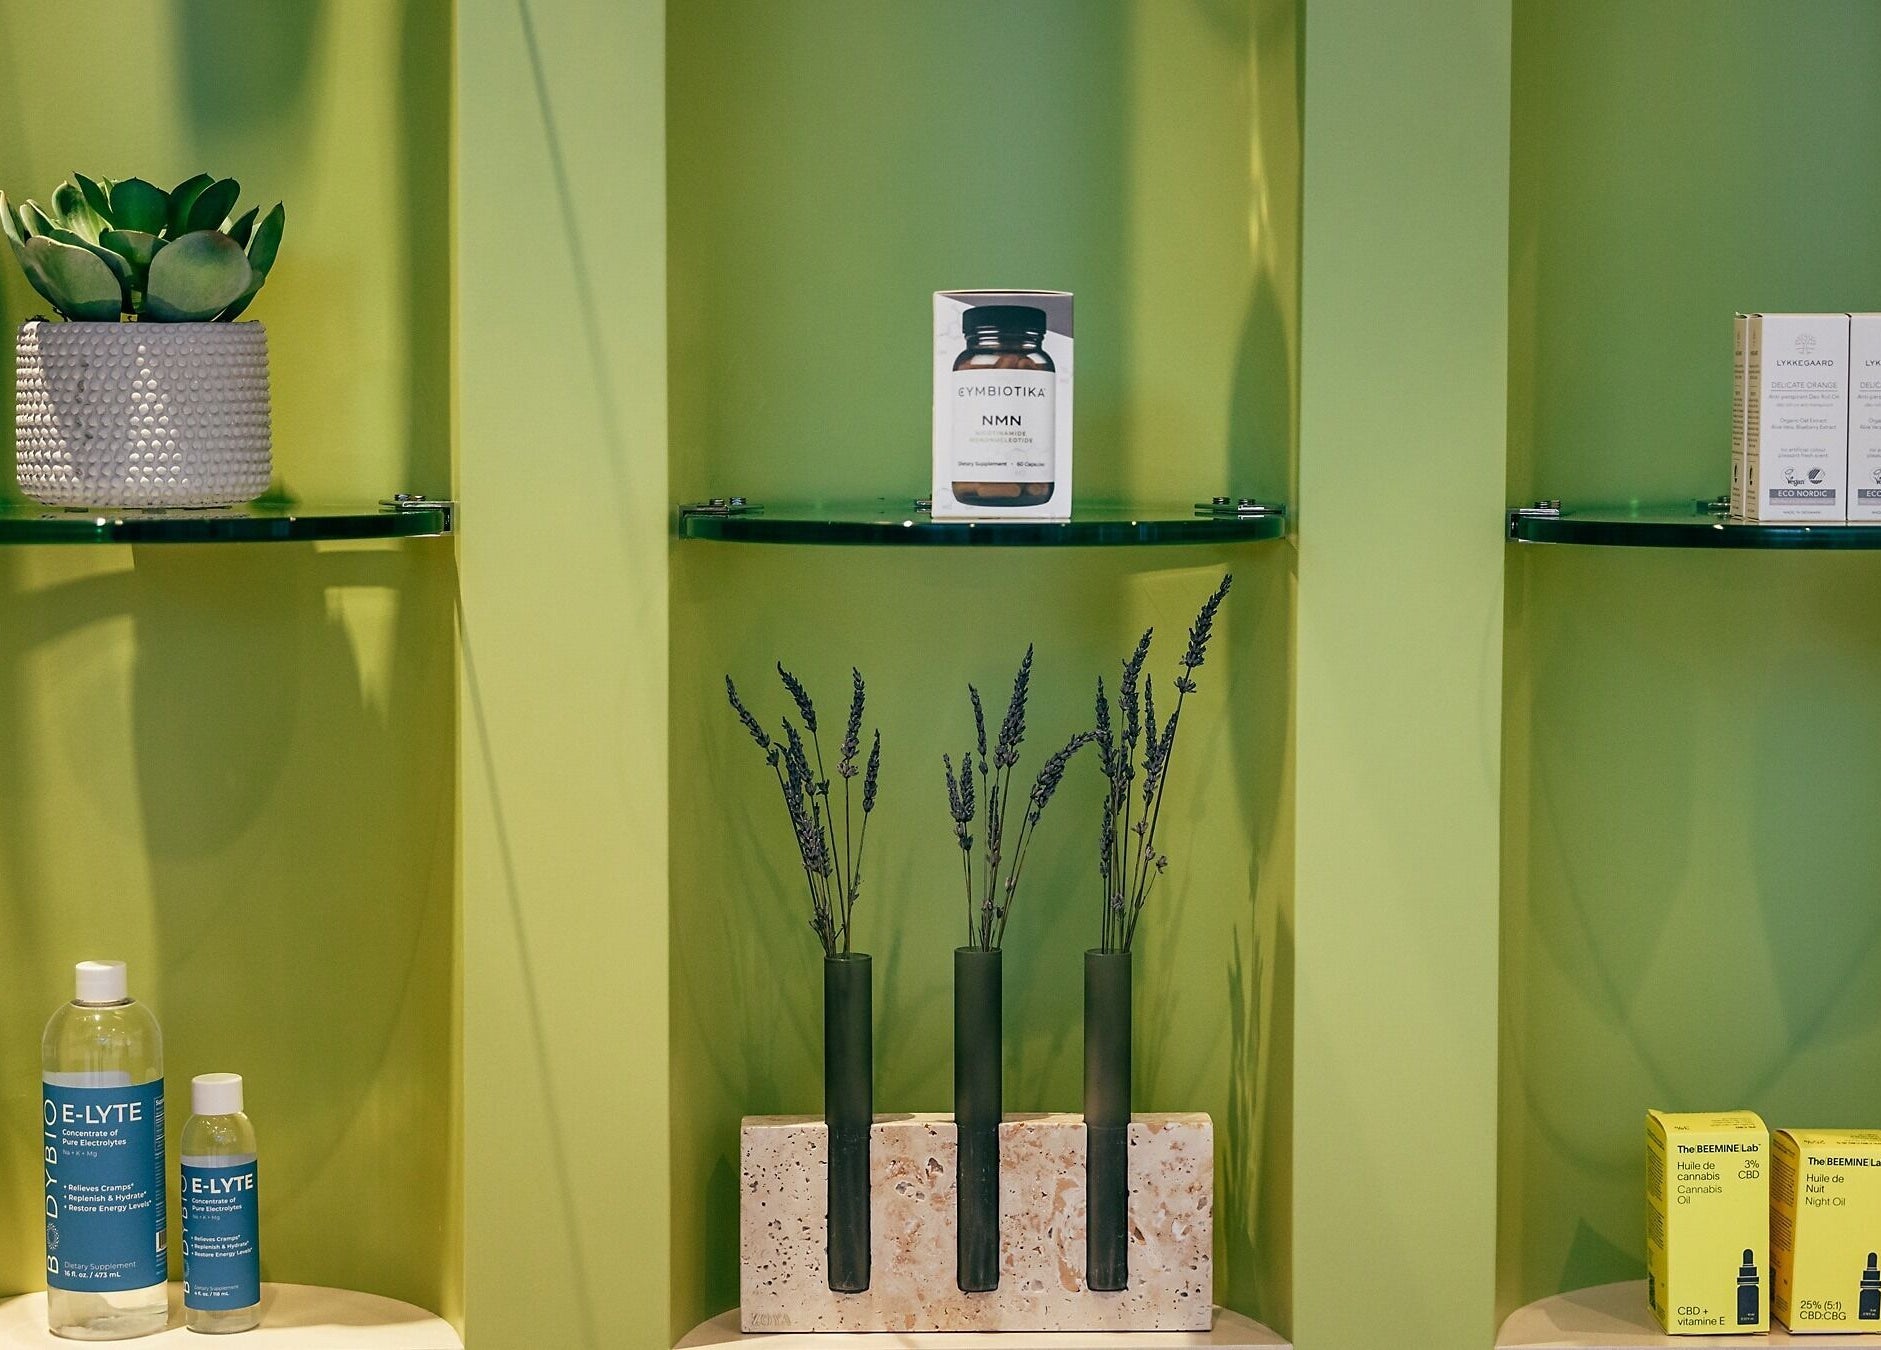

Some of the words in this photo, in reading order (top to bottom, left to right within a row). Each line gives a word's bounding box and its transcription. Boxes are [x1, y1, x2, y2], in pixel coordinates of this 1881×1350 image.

[982, 415, 1022, 426] NMN
[62, 1102, 142, 1124] E-LYTE
[62, 1128, 108, 1137] Concentrate
[109, 1128, 118, 1136] of
[80, 1138, 126, 1148] Electrolytes
[1677, 1145, 1694, 1154] The
[1696, 1144, 1740, 1153] BEEMINE
[1677, 1162, 1700, 1170] Huile
[1702, 1162, 1716, 1170] de
[1744, 1160, 1760, 1169] 3%
[1808, 1156, 1825, 1166] The
[1826, 1158, 1869, 1167] BEEMINE
[1677, 1172, 1720, 1181] cannabis
[1738, 1170, 1760, 1180] CBD
[1806, 1173, 1830, 1183] Huile
[1832, 1174, 1844, 1184] de
[68, 1184, 99, 1192] Relieves
[192, 1174, 254, 1194] E-LYTE
[1677, 1184, 1722, 1194] Cannabis
[1806, 1184, 1824, 1194] Nuit
[68, 1194, 106, 1202] Replenish
[192, 1197, 228, 1205] Concentrate
[1677, 1196, 1691, 1204] Oil
[1805, 1196, 1830, 1208] Night
[1832, 1197, 1846, 1206] Oil
[98, 1204, 127, 1212] Energy
[64, 1262, 88, 1271] Dietary
[90, 1261, 136, 1270] Supplement
[1677, 1306, 1700, 1316] CBD
[1800, 1300, 1822, 1310] 25%
[1824, 1300, 1842, 1312] (5:1)
[1800, 1310, 1847, 1321] CBD:CBG
[1677, 1316, 1717, 1326] vitamine
[1720, 1317, 1726, 1326] E
